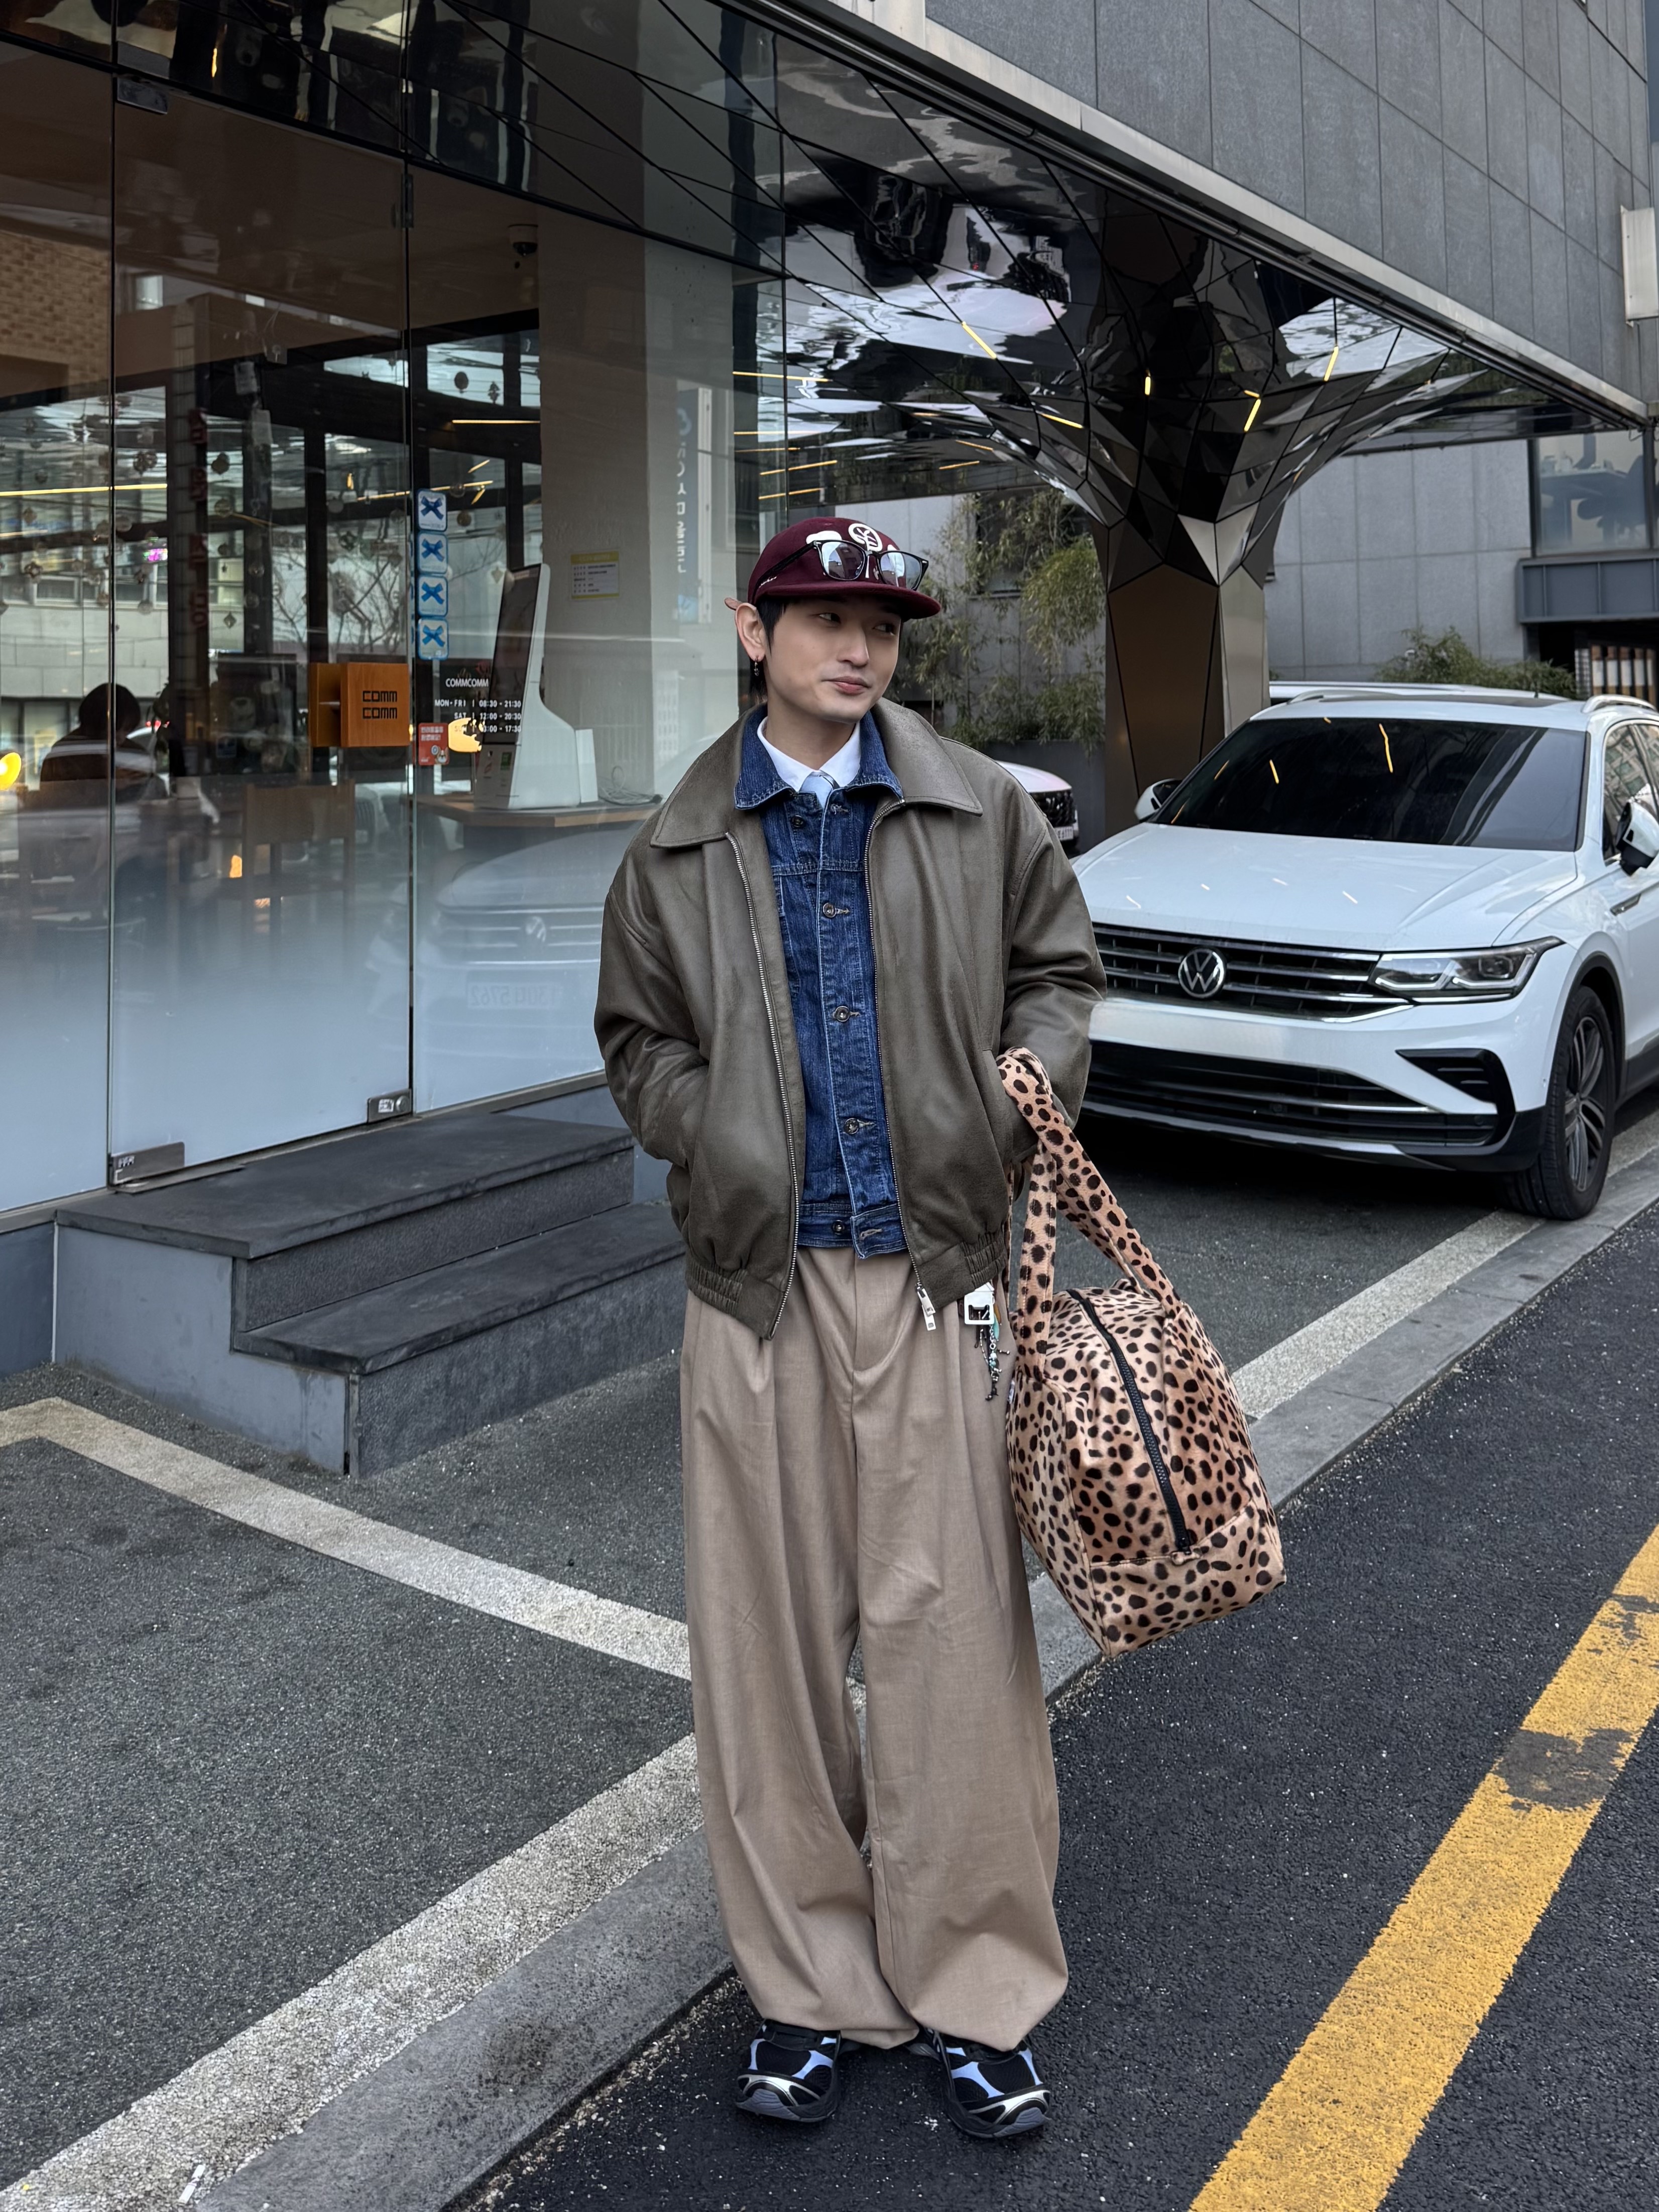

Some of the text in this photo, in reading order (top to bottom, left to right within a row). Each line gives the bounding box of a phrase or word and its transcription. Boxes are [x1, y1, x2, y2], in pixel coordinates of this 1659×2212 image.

[445, 678, 489, 687] COMMCOMM
[504, 700, 521, 708] 21:30
[480, 712, 498, 720] 12:00
[480, 725, 498, 733] 3:00
[1181, 951, 1222, 994] VW
